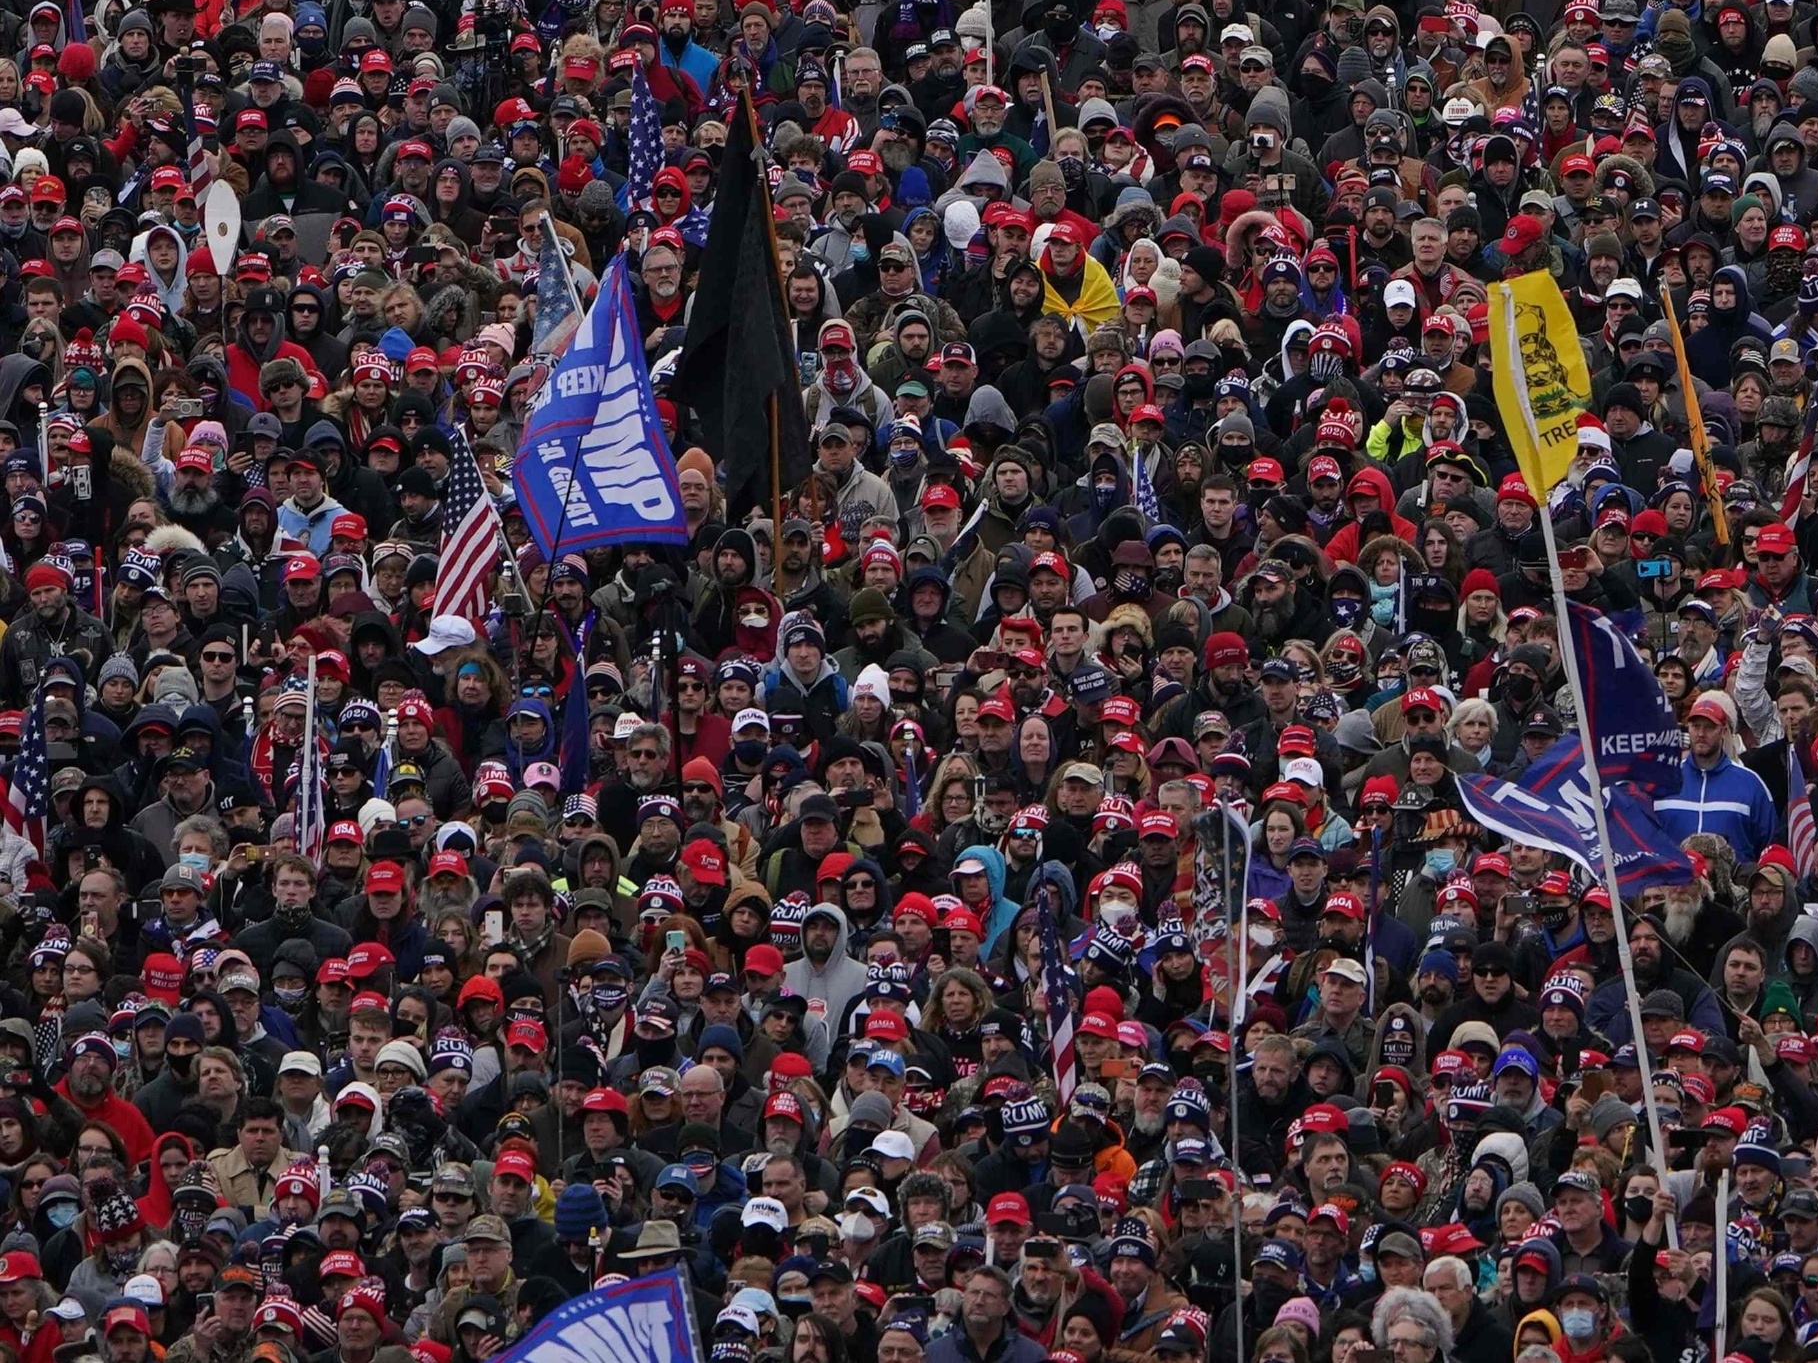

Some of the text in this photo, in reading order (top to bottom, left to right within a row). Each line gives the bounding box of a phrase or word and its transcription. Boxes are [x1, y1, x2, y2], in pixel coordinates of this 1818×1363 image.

[1448, 107, 1469, 115] TRUMP
[1426, 315, 1448, 327] USA
[1320, 426, 1345, 438] 2020
[1540, 419, 1578, 450] TRE
[548, 464, 597, 528] GREAT
[871, 552, 891, 562] TRUMP
[1408, 691, 1428, 702] USA
[341, 709, 368, 723] 2020
[738, 713, 765, 723] TRUMP
[1602, 732, 1648, 756] KEEP
[335, 826, 356, 835] USA
[1325, 898, 1352, 910] MAGA
[772, 932, 798, 945] 2020
[228, 975, 253, 983] TRUMP
[1383, 1043, 1412, 1053] TRUMP
[873, 1050, 899, 1063] USAF
[772, 1098, 800, 1106] AMERICA
[775, 1104, 796, 1112] GREAT
[1177, 1140, 1204, 1150] TRUMP
[752, 1204, 781, 1213] TRUMP
[720, 1311, 749, 1320] TRUMP
